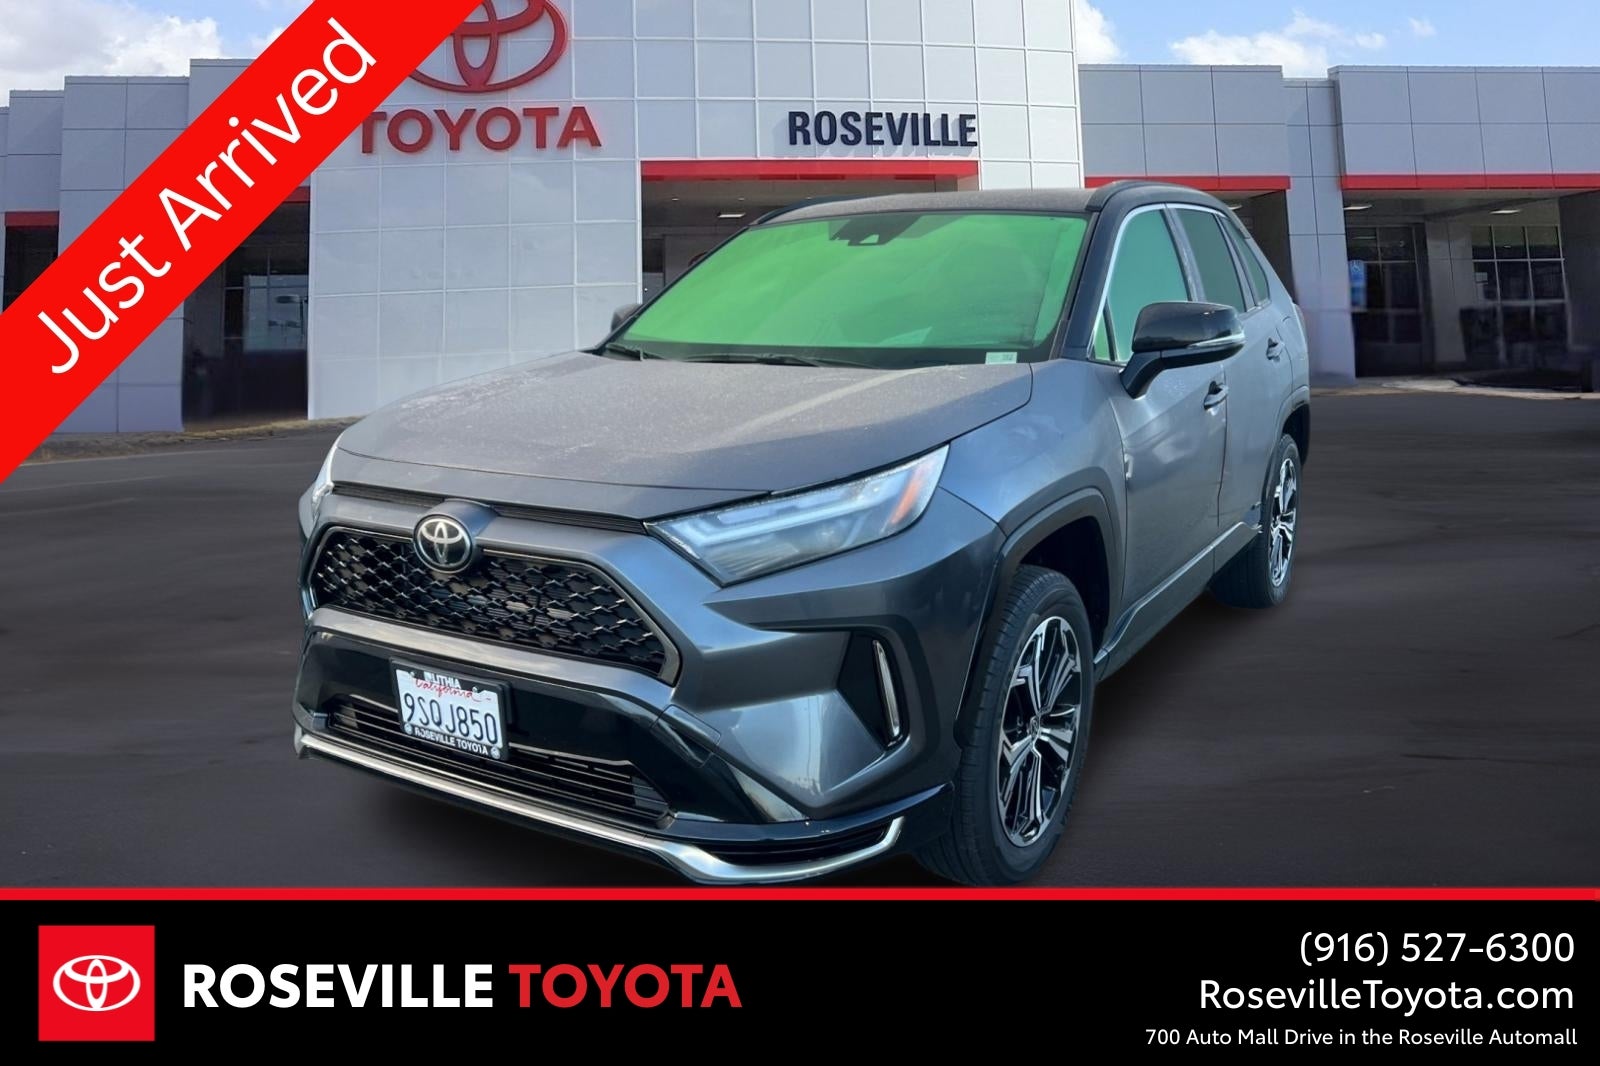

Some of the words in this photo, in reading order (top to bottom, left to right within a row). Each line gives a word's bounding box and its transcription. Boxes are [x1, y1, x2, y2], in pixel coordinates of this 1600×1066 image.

[362, 107, 602, 154] TOYOTA
[788, 110, 978, 148] ROSEVILLE
[415, 678, 474, 698] California
[403, 692, 498, 745] 9SQJ850
[414, 726, 456, 747] ROSEVILLE
[456, 739, 489, 756] TOYOTA
